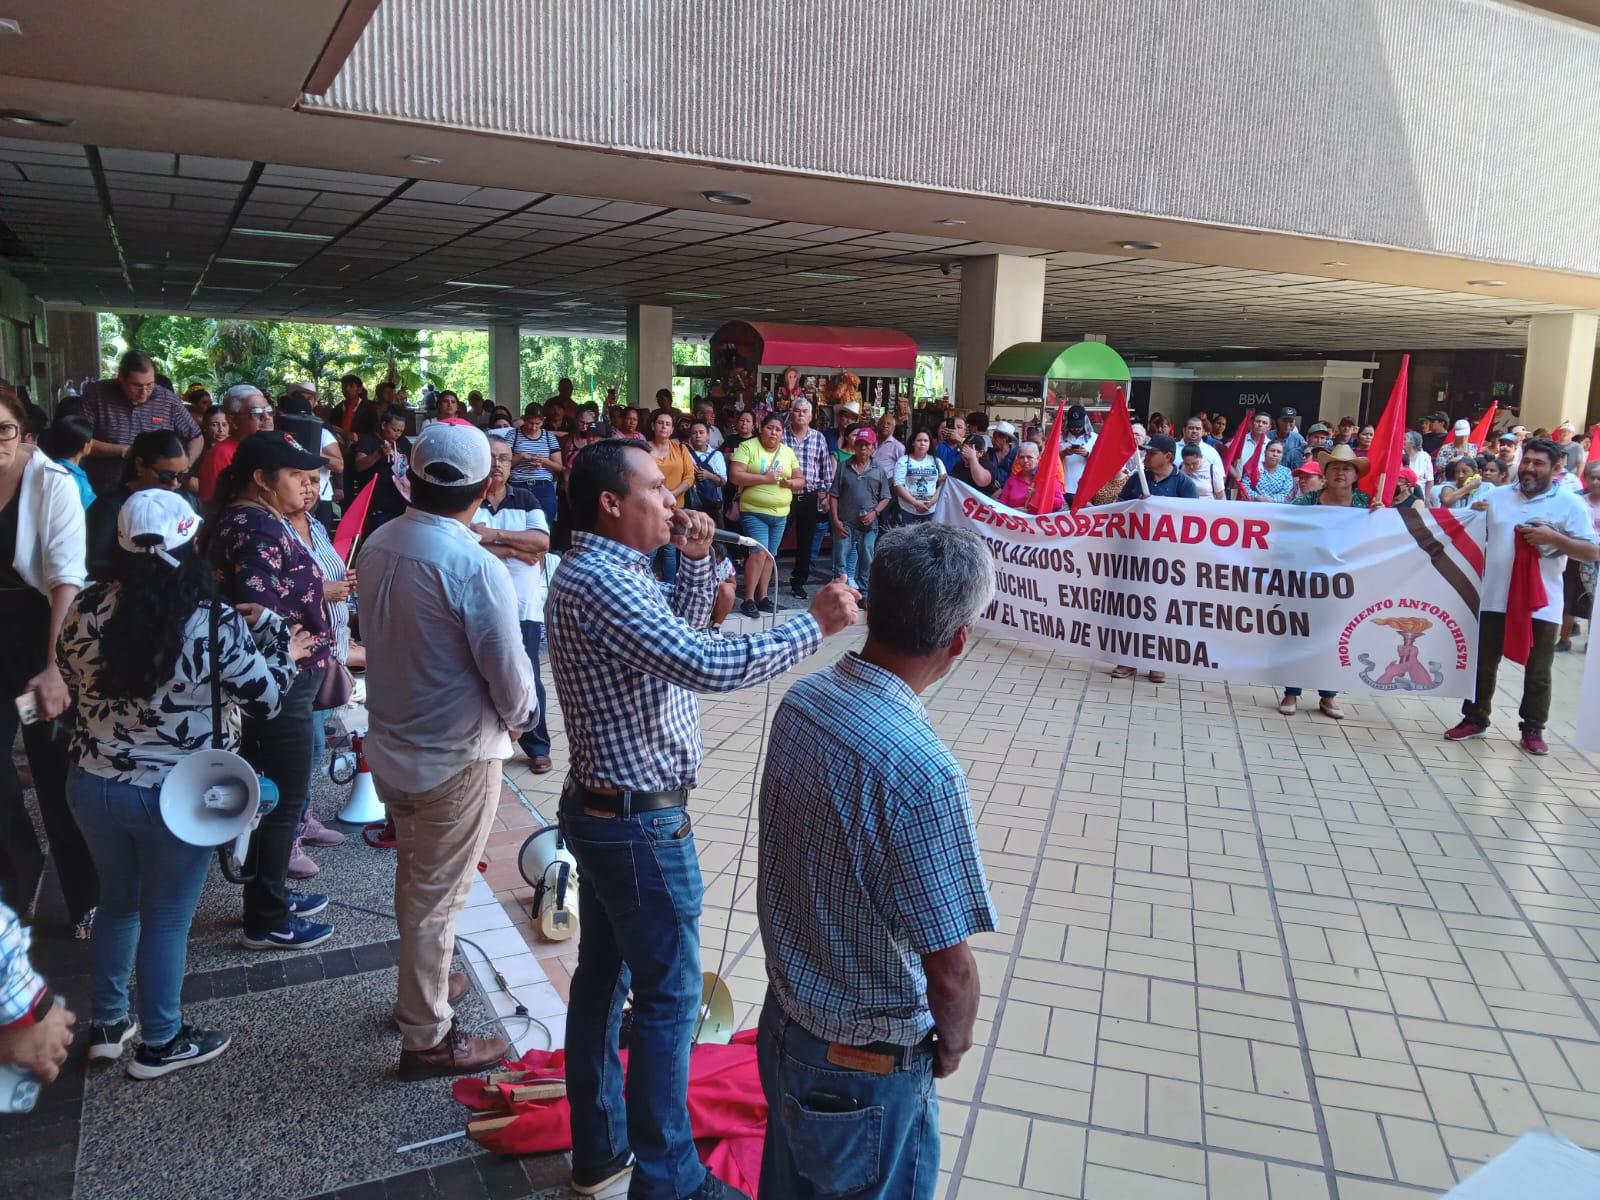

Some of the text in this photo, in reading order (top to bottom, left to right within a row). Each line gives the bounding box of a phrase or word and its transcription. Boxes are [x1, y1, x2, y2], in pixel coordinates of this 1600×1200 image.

[1239, 393, 1272, 405] BBVA
[1035, 511, 1270, 550] GOBERNADOR
[980, 535, 1355, 600] SPLAZADOS, VIVIMOS RENTANDO
[980, 599, 1219, 669] N EL TEMA DE VIVIENDA.
[994, 566, 1310, 638] ÚCHIL, EXIGIMOS ATENCIÓN
[1338, 598, 1468, 672] MOVIMIENTO ANTORCHISTA
